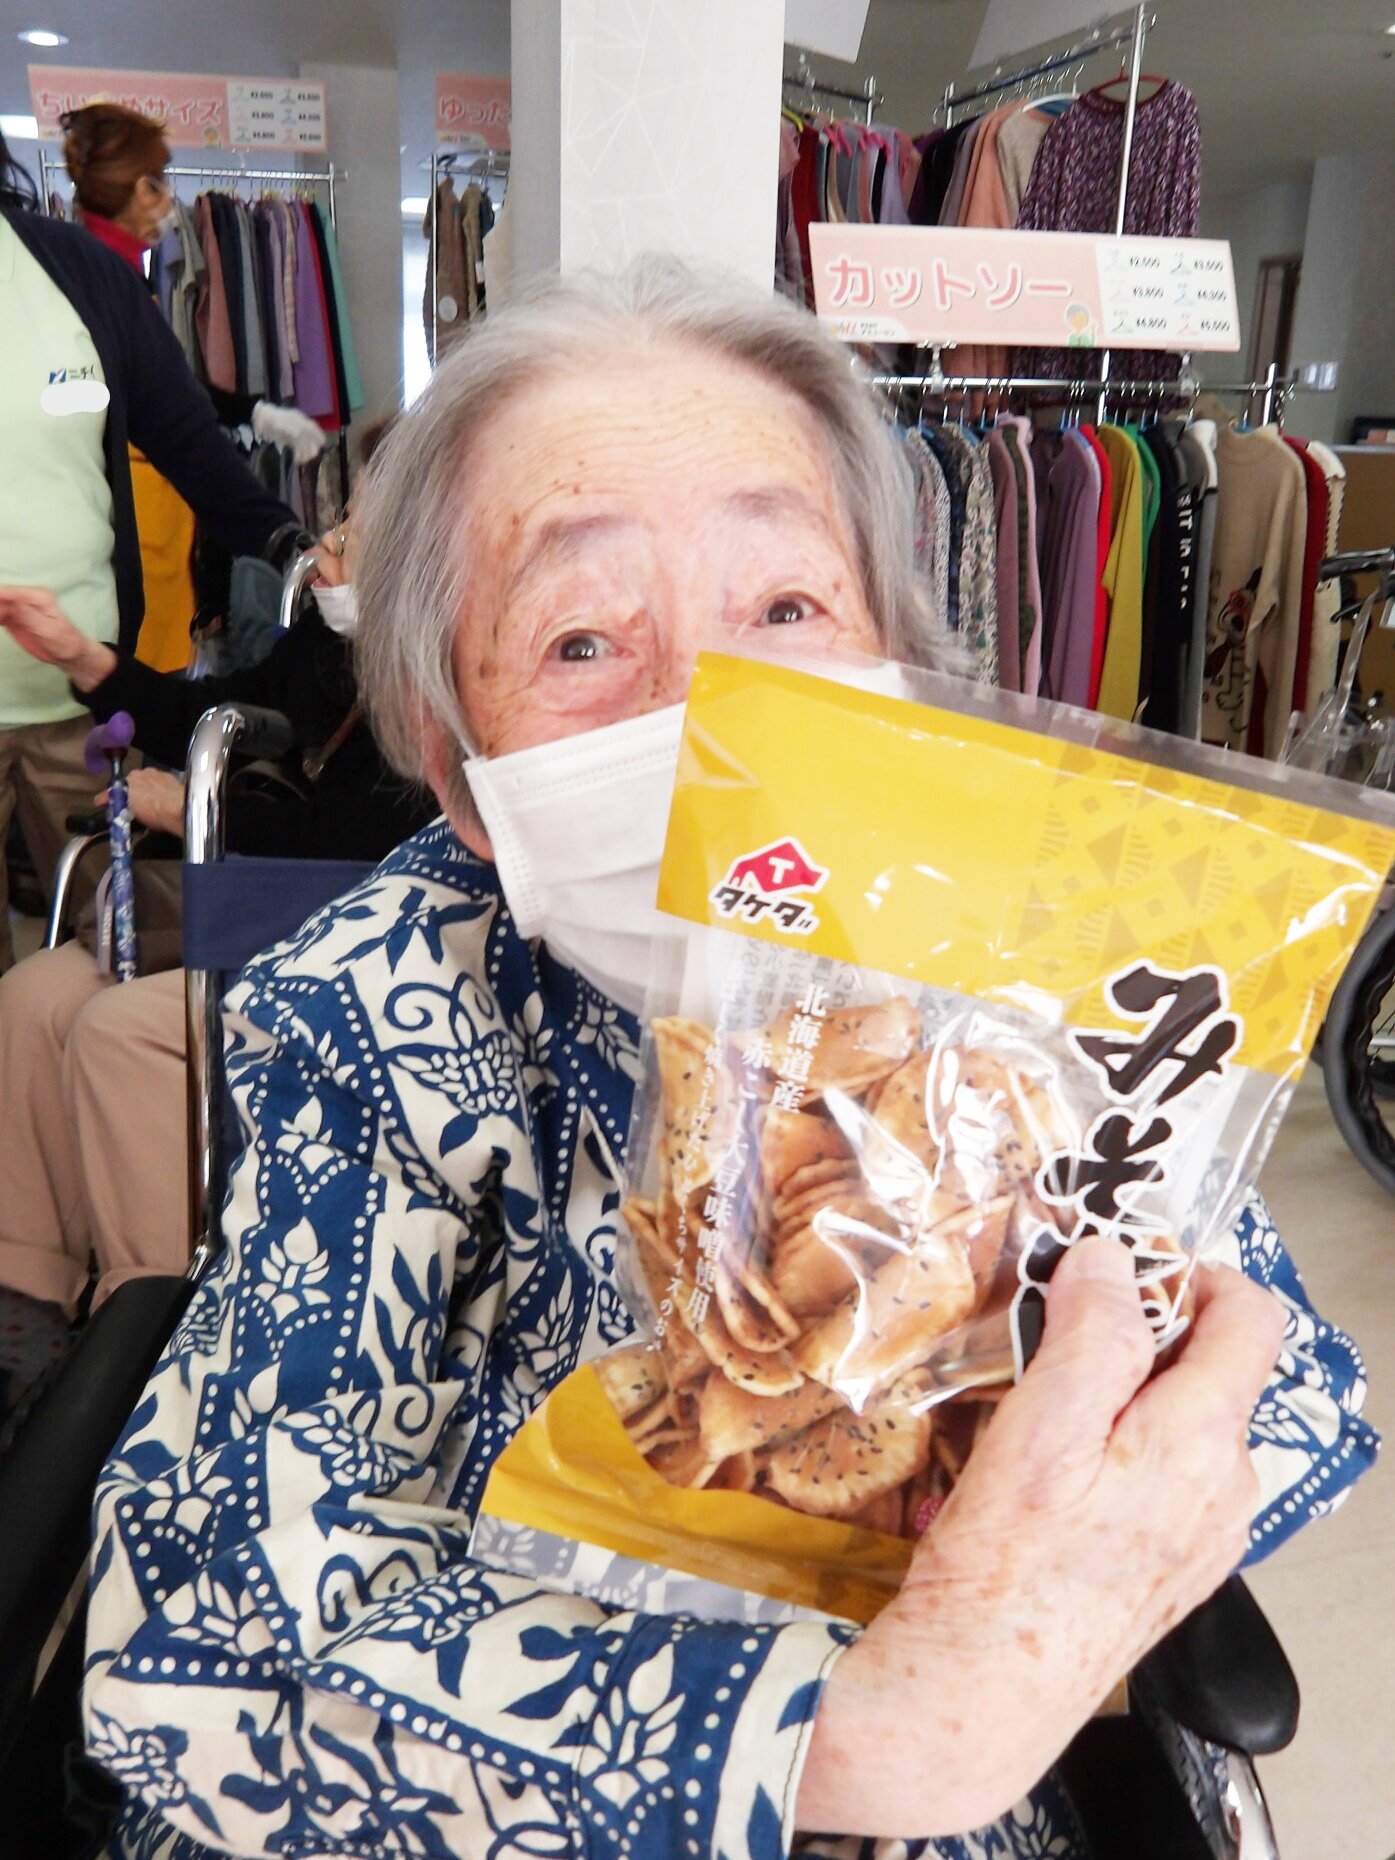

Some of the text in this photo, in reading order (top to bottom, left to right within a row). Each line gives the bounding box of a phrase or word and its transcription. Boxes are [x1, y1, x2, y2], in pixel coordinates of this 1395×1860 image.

[826, 255, 1073, 311] カットソー
[768, 856, 796, 885] T
[713, 885, 814, 930] タケダ
[770, 983, 829, 1114] 北海道産
